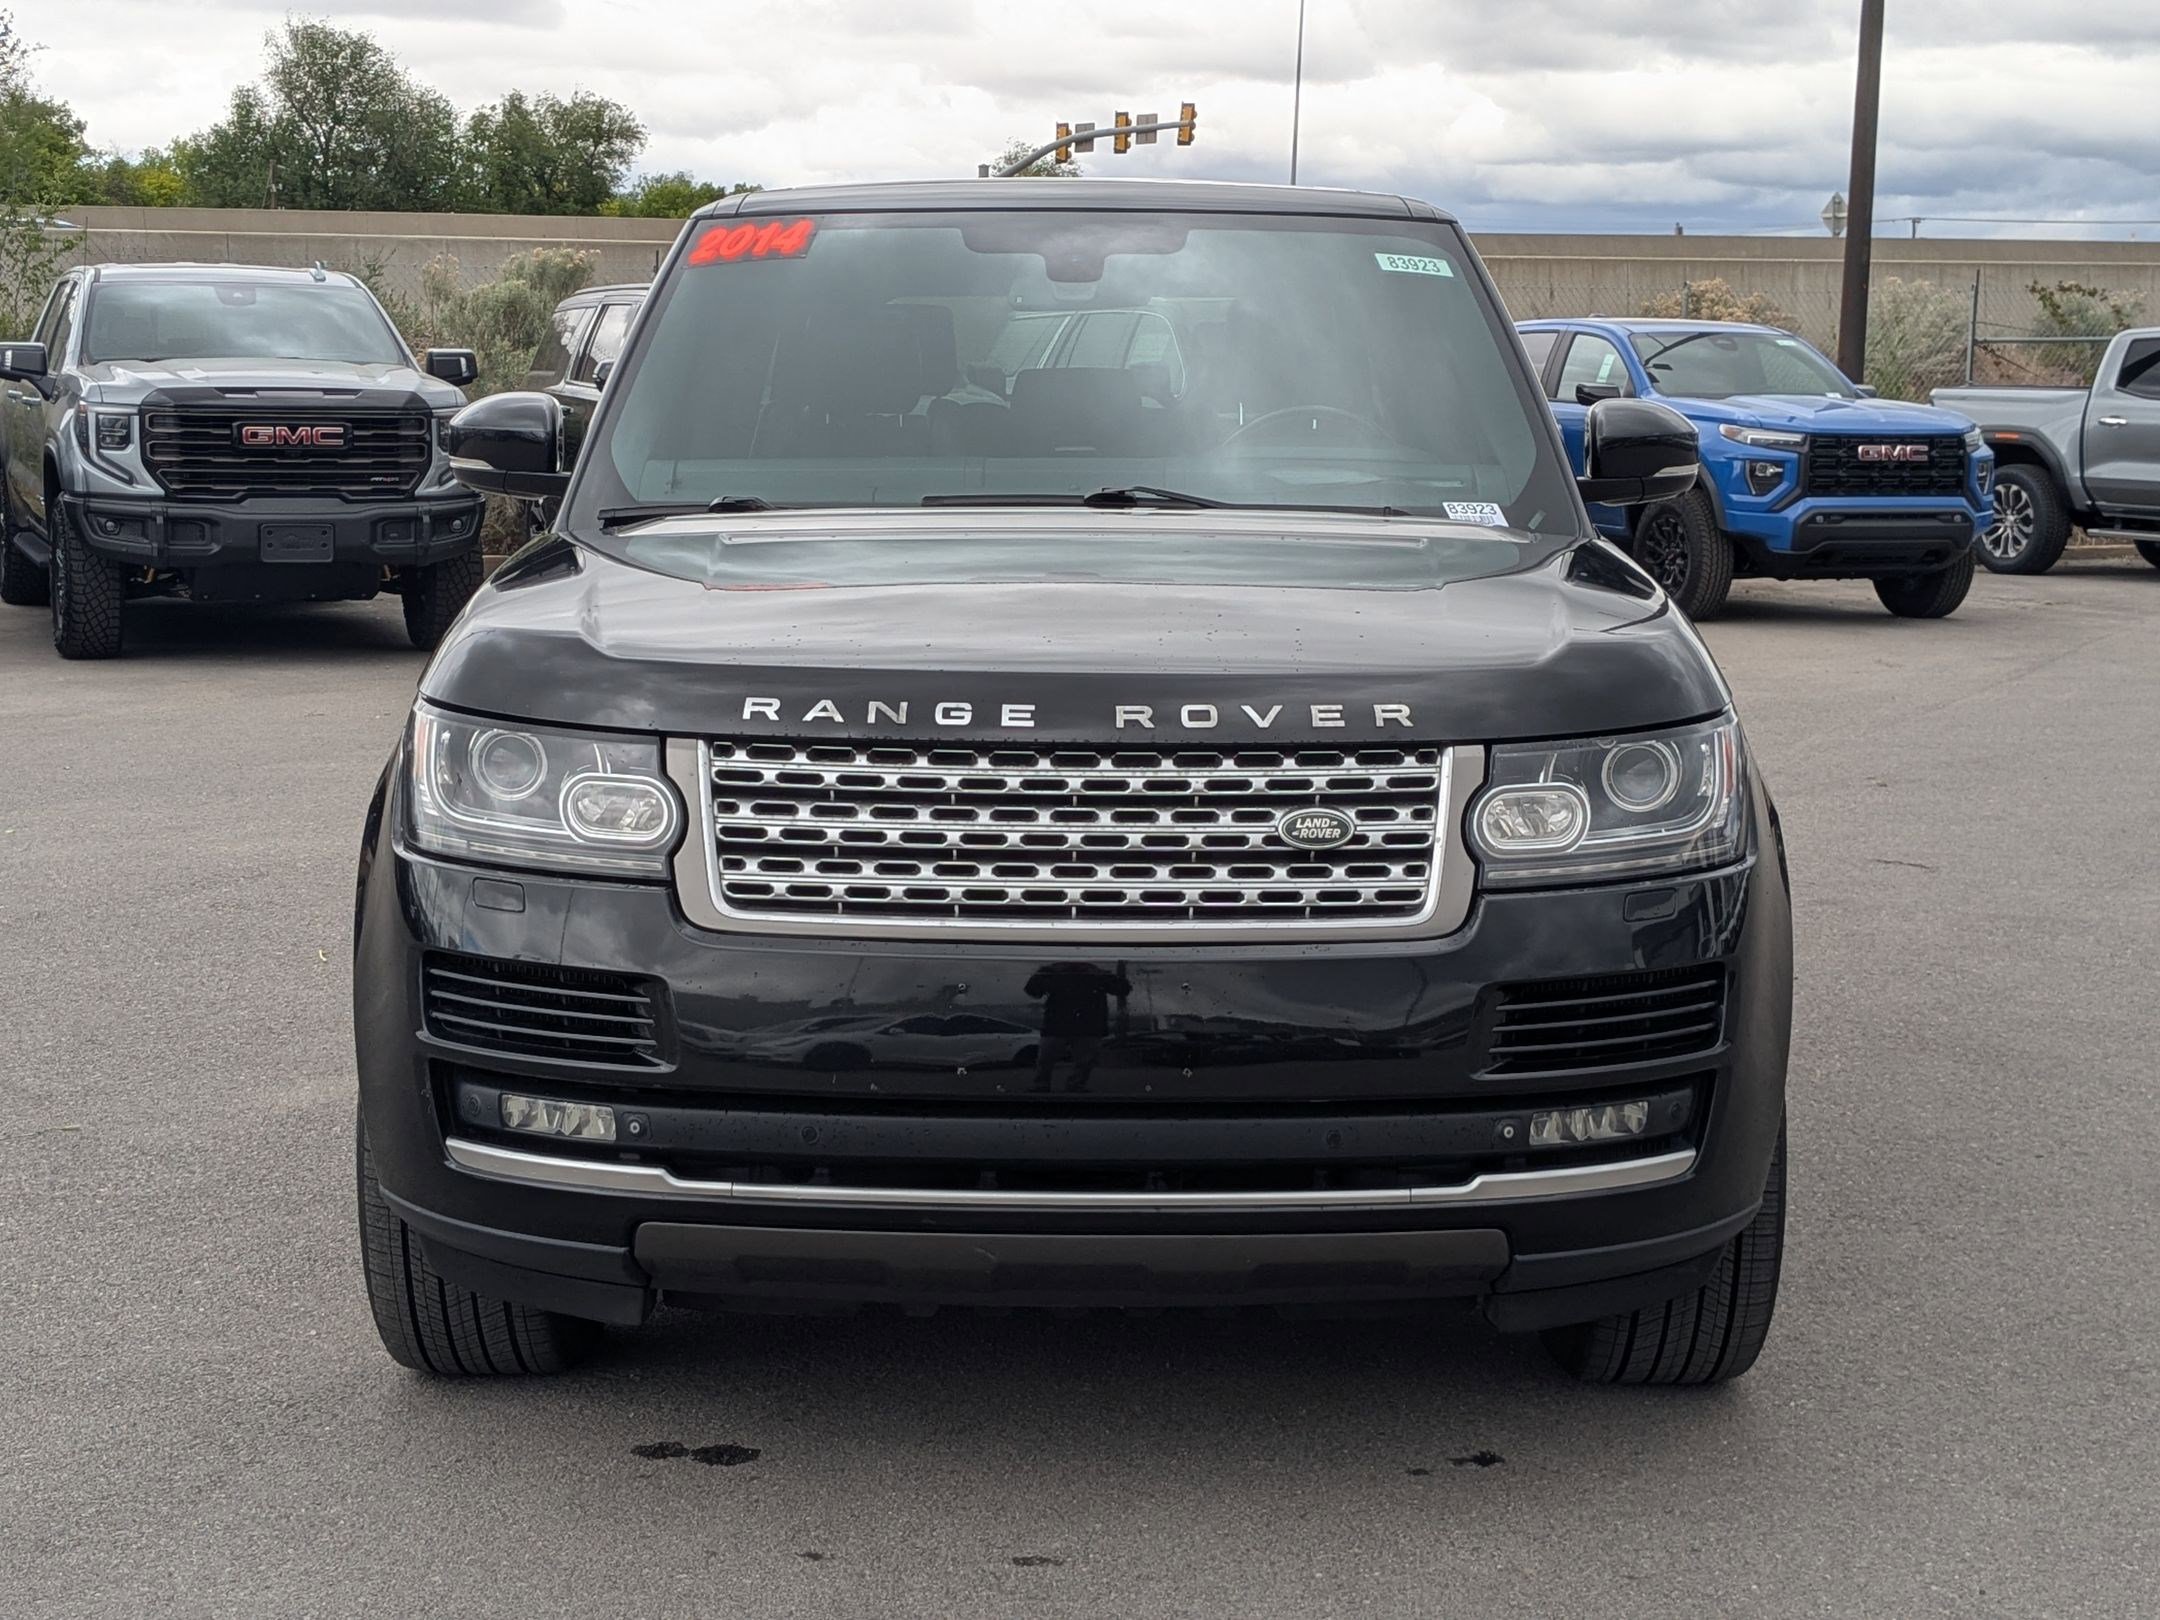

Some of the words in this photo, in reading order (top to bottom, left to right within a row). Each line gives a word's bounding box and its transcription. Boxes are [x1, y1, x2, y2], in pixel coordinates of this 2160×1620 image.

[688, 218, 814, 265] 2014
[1387, 256, 1440, 273] 83923
[242, 426, 344, 445] GMC
[1858, 445, 1929, 461] GMC
[1447, 503, 1497, 515] 83923
[742, 697, 1035, 727] RANGE
[1115, 704, 1414, 729] ROVER
